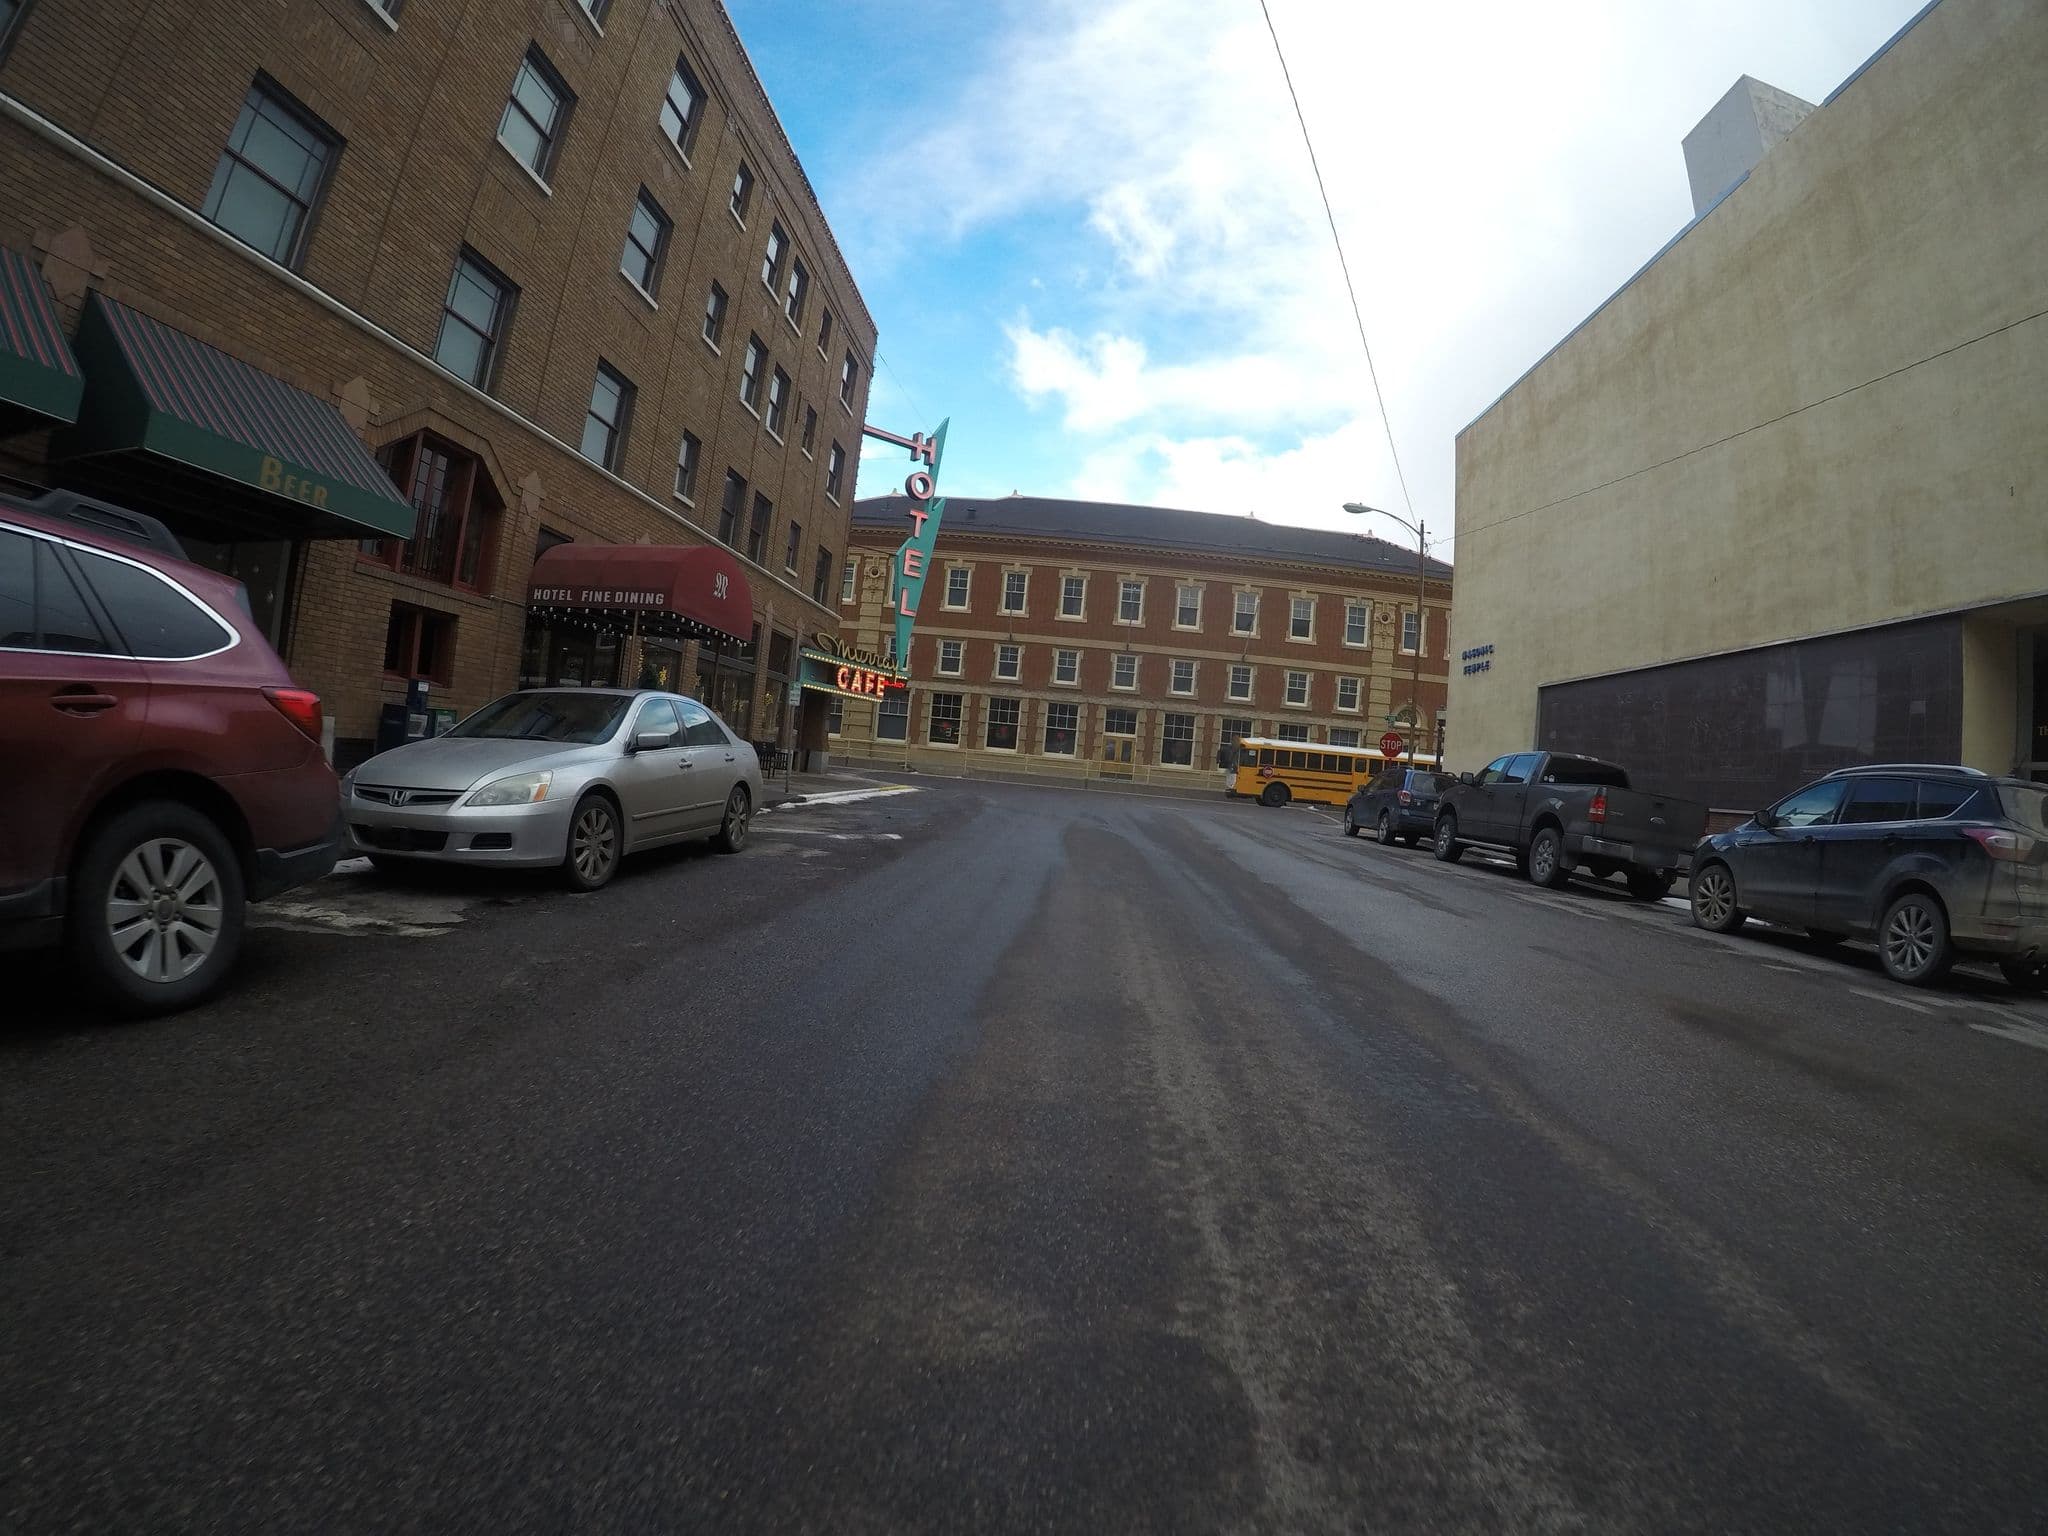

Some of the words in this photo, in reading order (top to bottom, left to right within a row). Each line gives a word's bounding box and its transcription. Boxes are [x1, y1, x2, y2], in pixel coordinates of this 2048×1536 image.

[900, 432, 937, 617] HOTEL
[533, 588, 573, 601] HOTEL
[581, 590, 611, 603] FINE
[614, 591, 665, 605] DINING
[836, 665, 886, 699] CAFE
[1380, 740, 1402, 750] STOP
